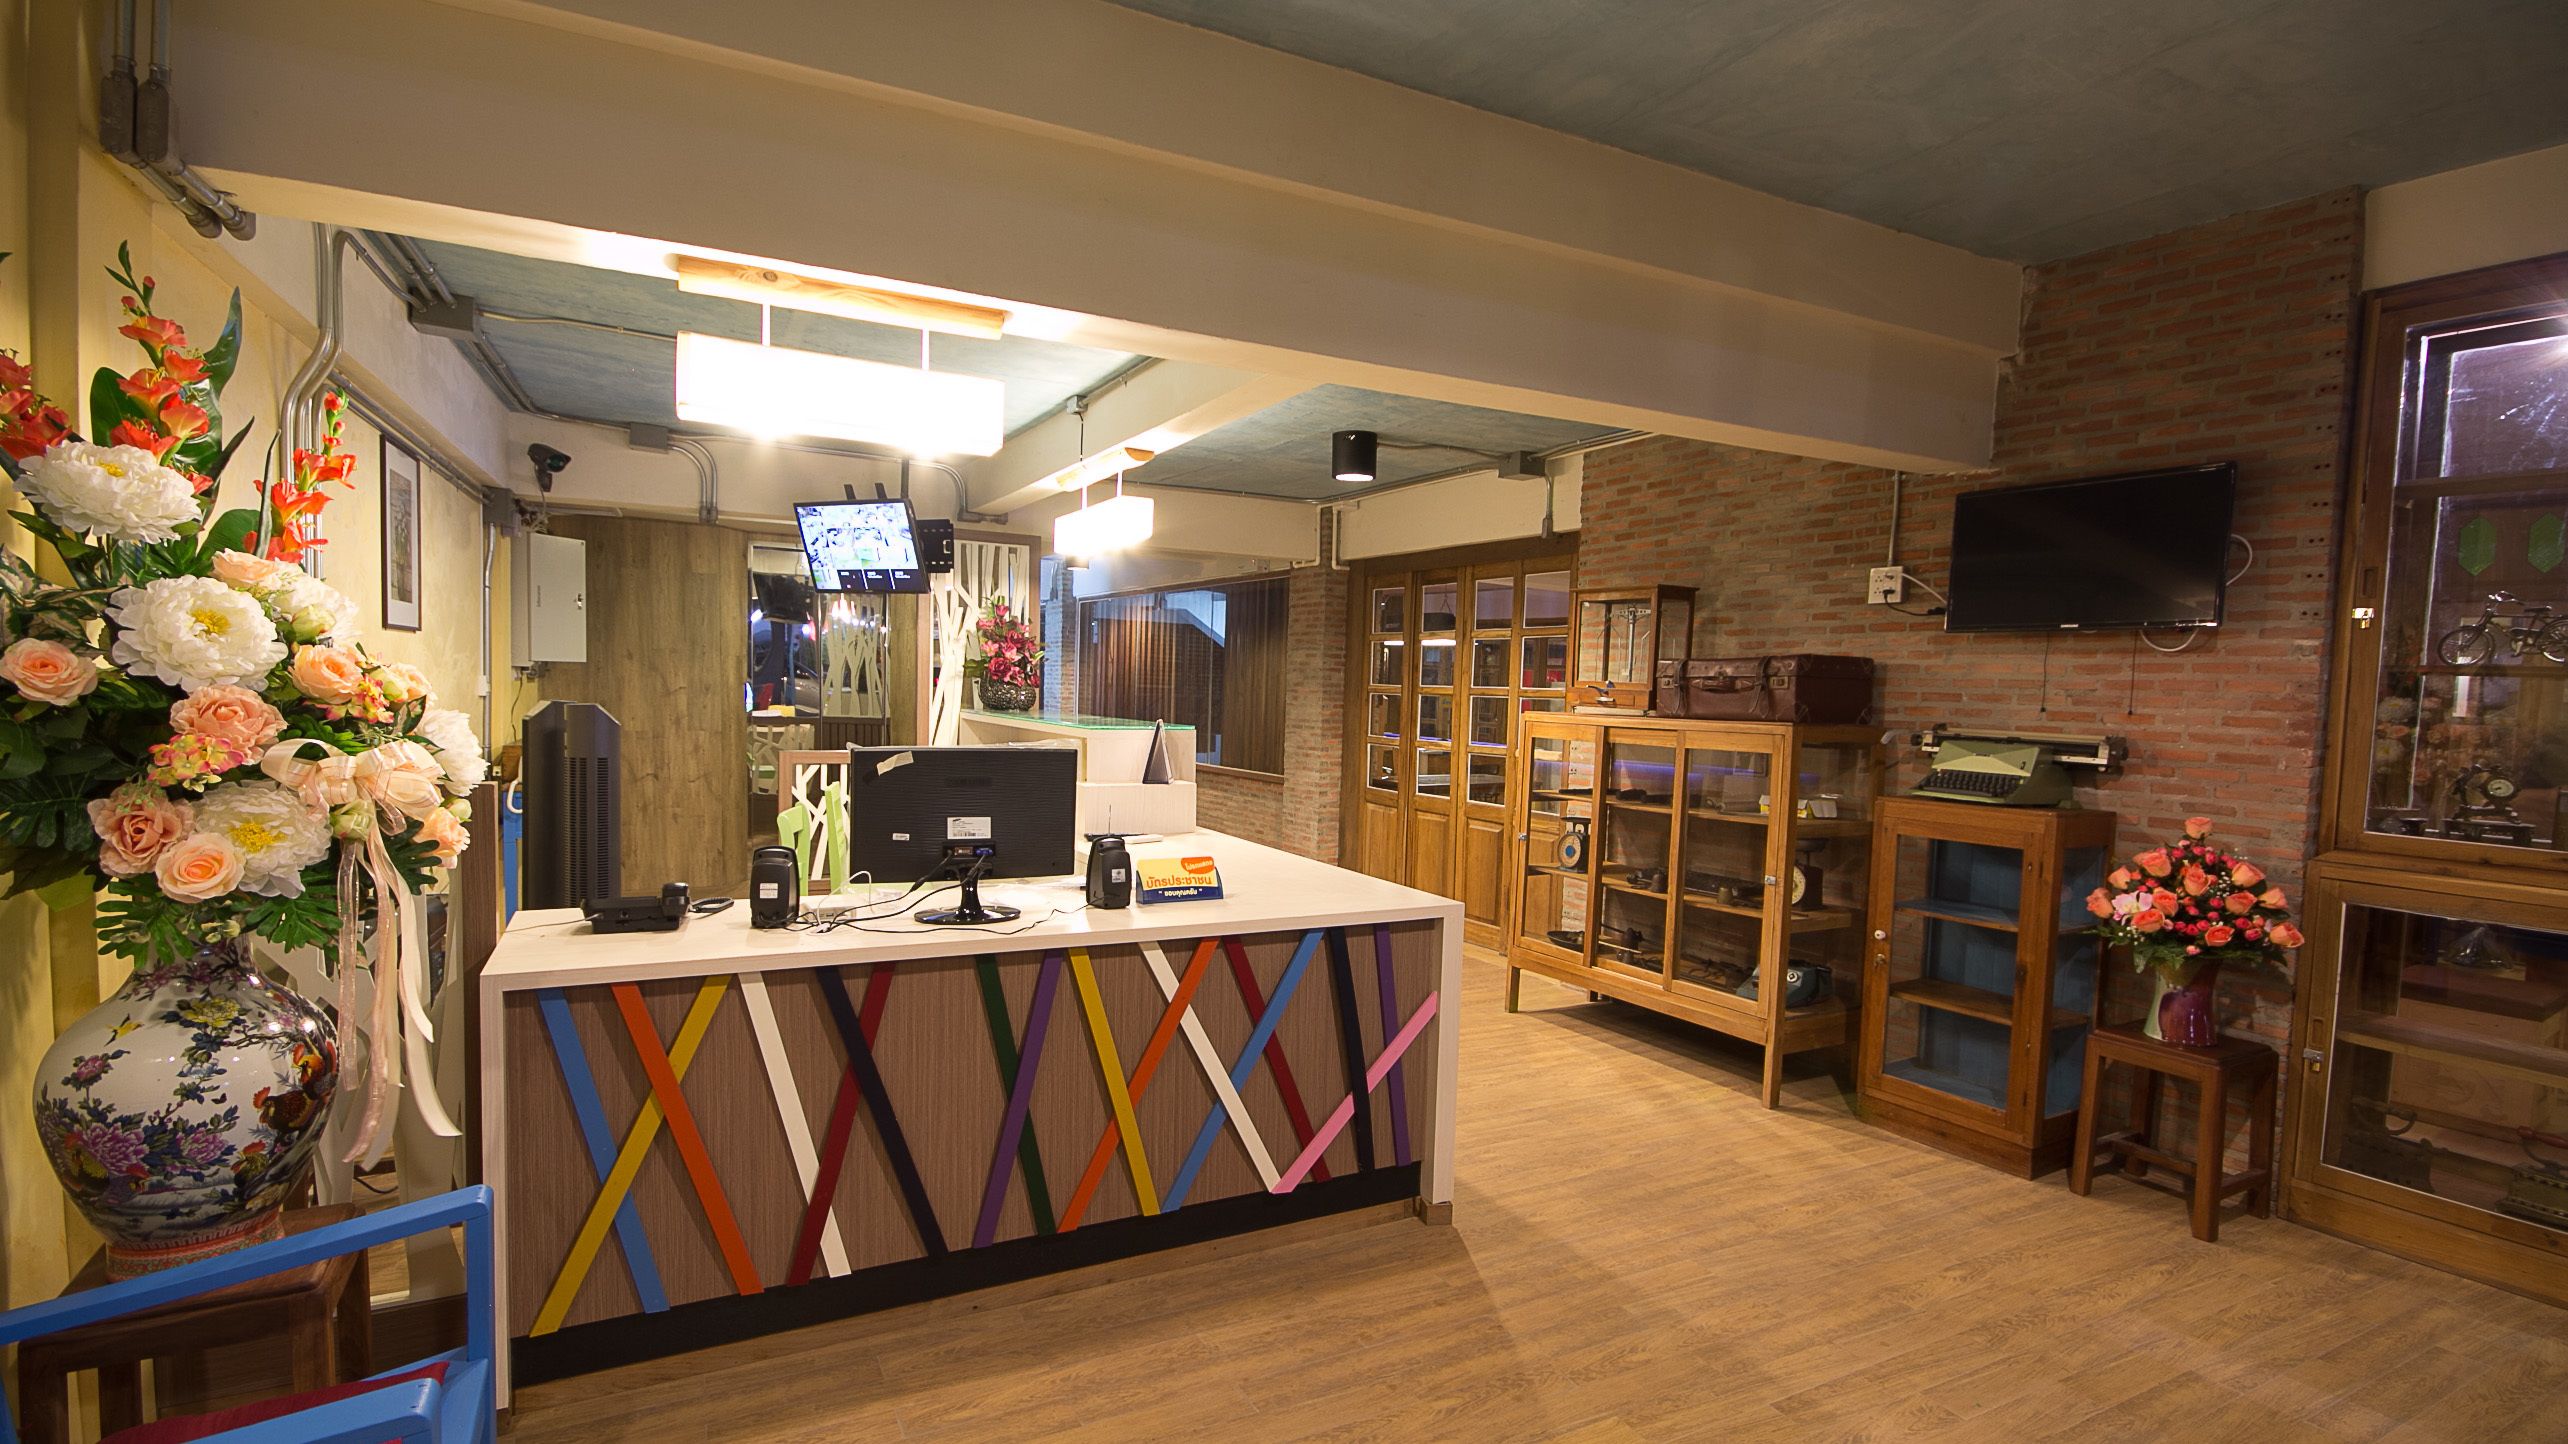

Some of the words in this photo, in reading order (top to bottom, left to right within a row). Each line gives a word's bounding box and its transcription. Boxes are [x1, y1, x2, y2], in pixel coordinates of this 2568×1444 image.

[1146, 874, 1212, 888] บัตรประชาชน
